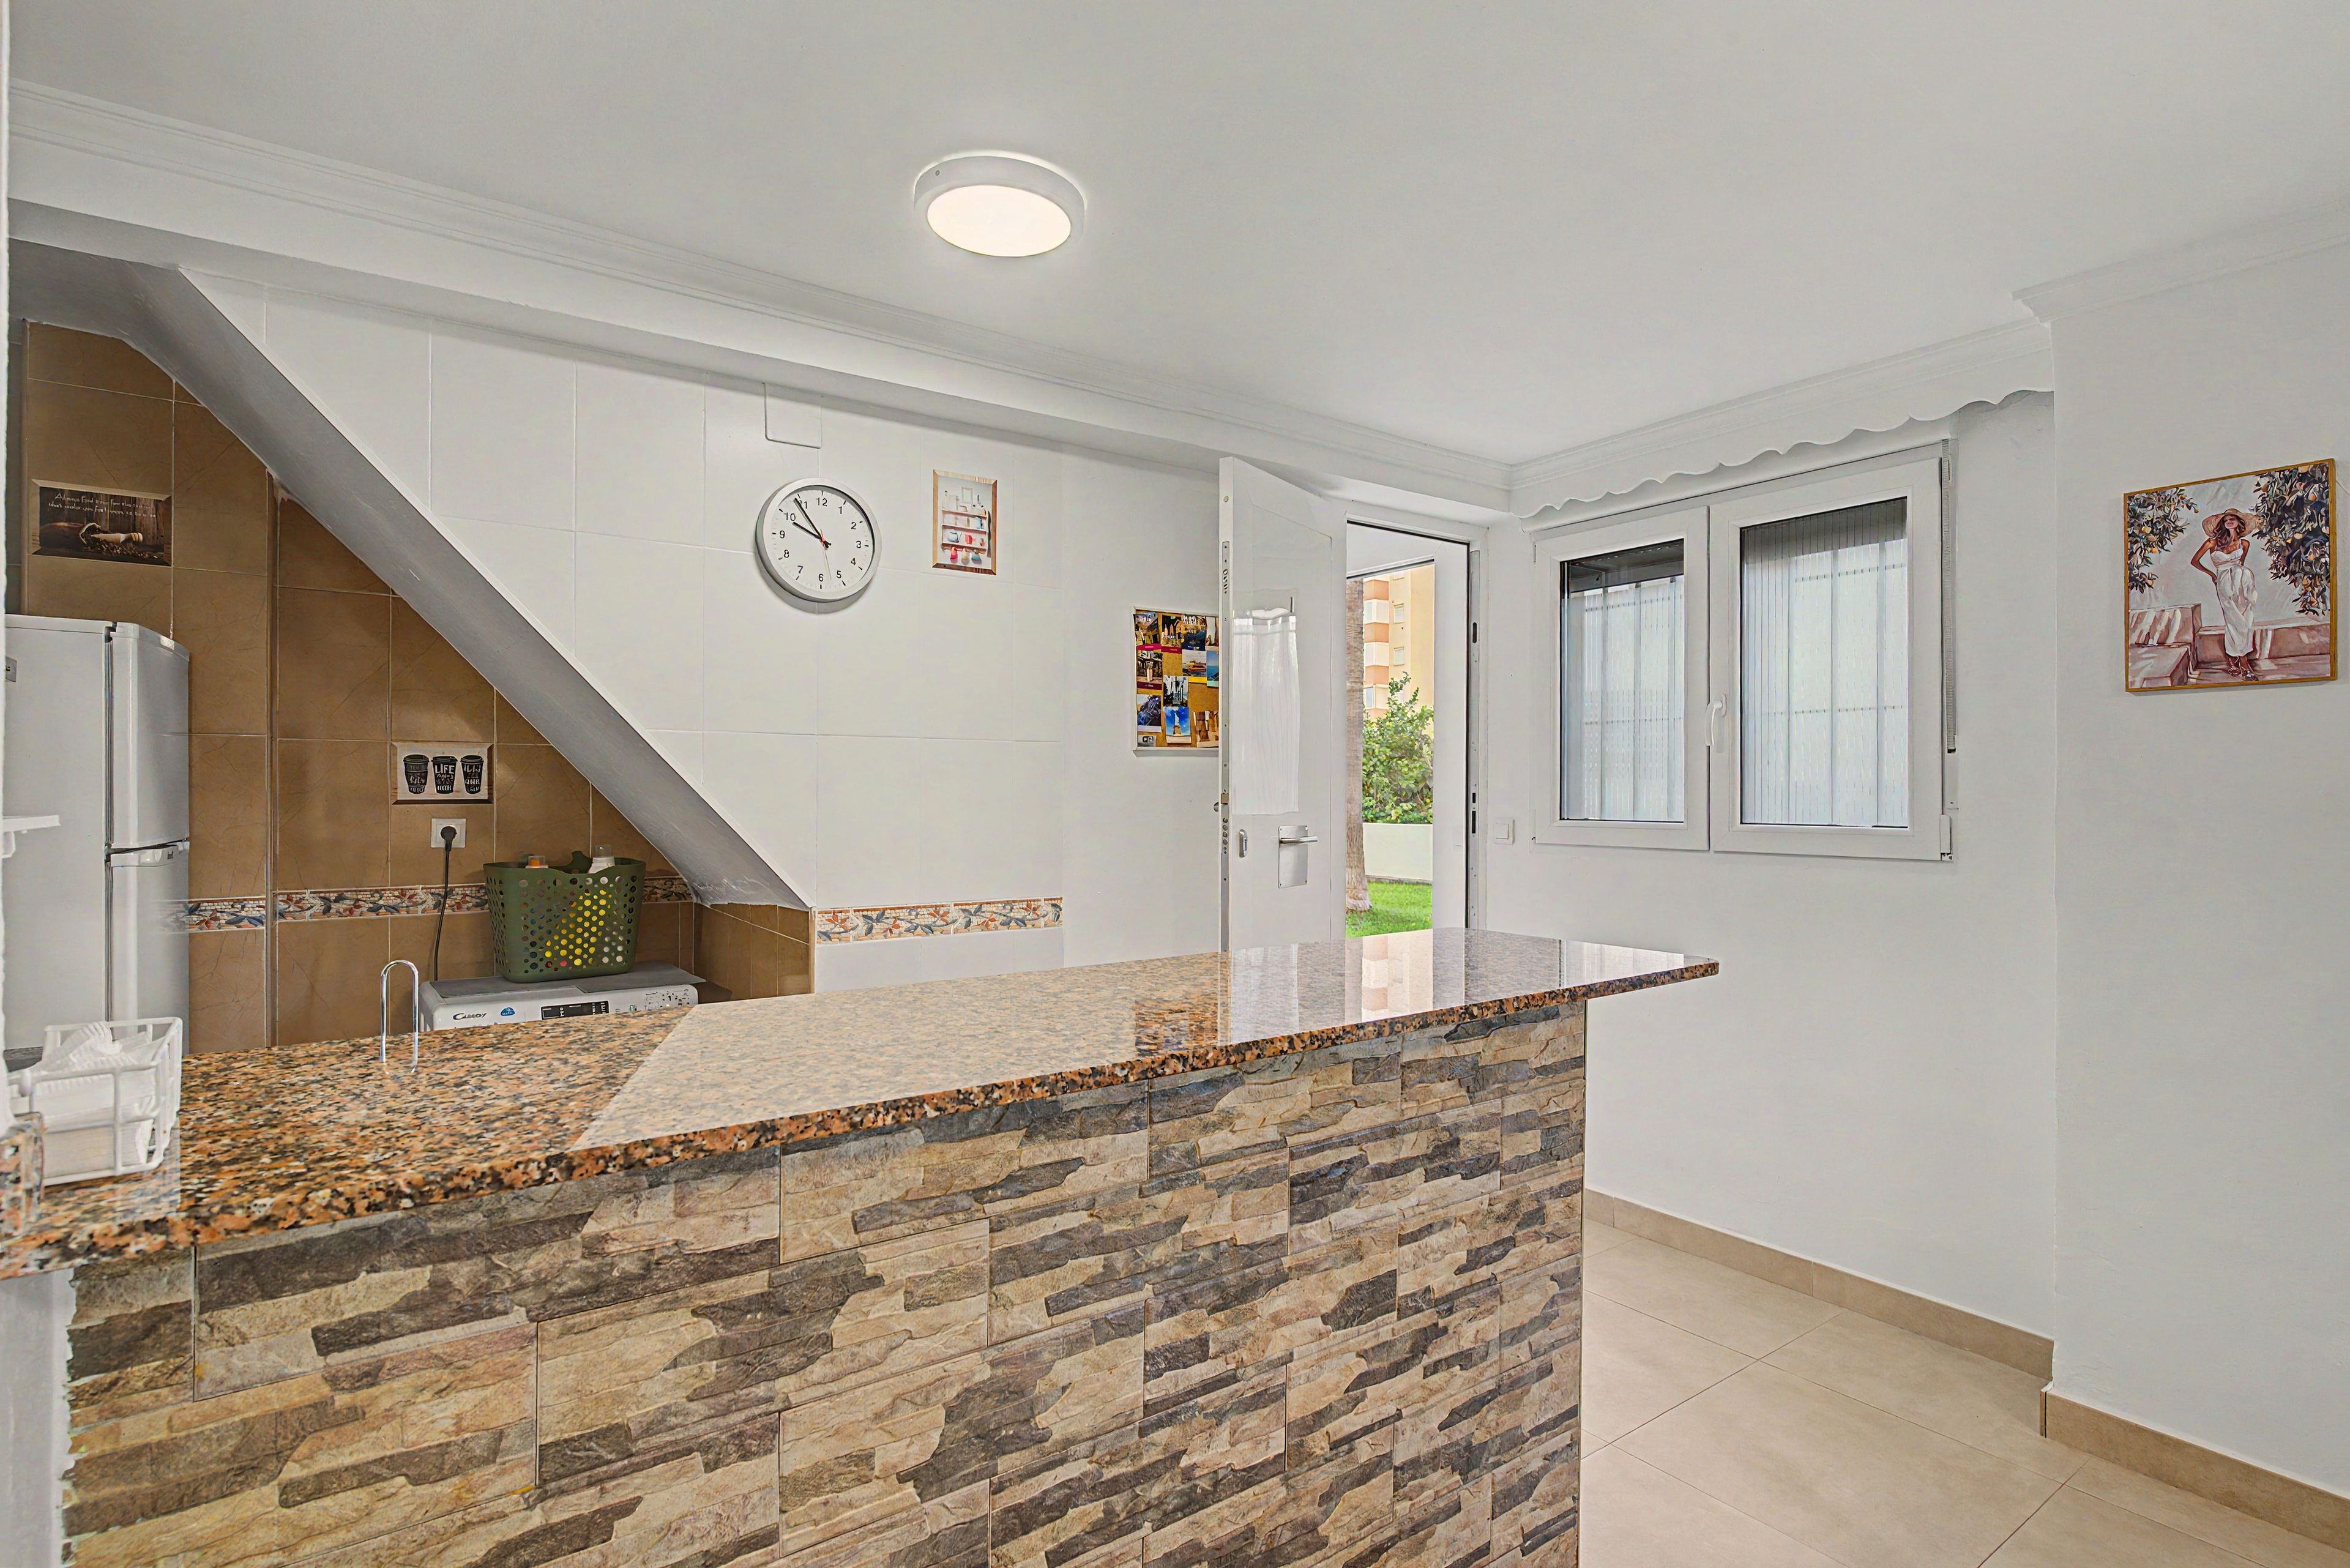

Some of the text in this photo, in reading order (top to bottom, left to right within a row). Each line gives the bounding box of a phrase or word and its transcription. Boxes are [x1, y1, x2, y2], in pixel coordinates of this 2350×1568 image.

[816, 497, 827, 507] 12
[783, 512, 796, 521] 10
[851, 521, 857, 530] 2
[779, 530, 785, 539] 9
[783, 550, 789, 558] 8
[797, 565, 804, 574] 7
[818, 573, 824, 582] 6
[836, 570, 842, 579] 5
[435, 764, 455, 774] LIFE
